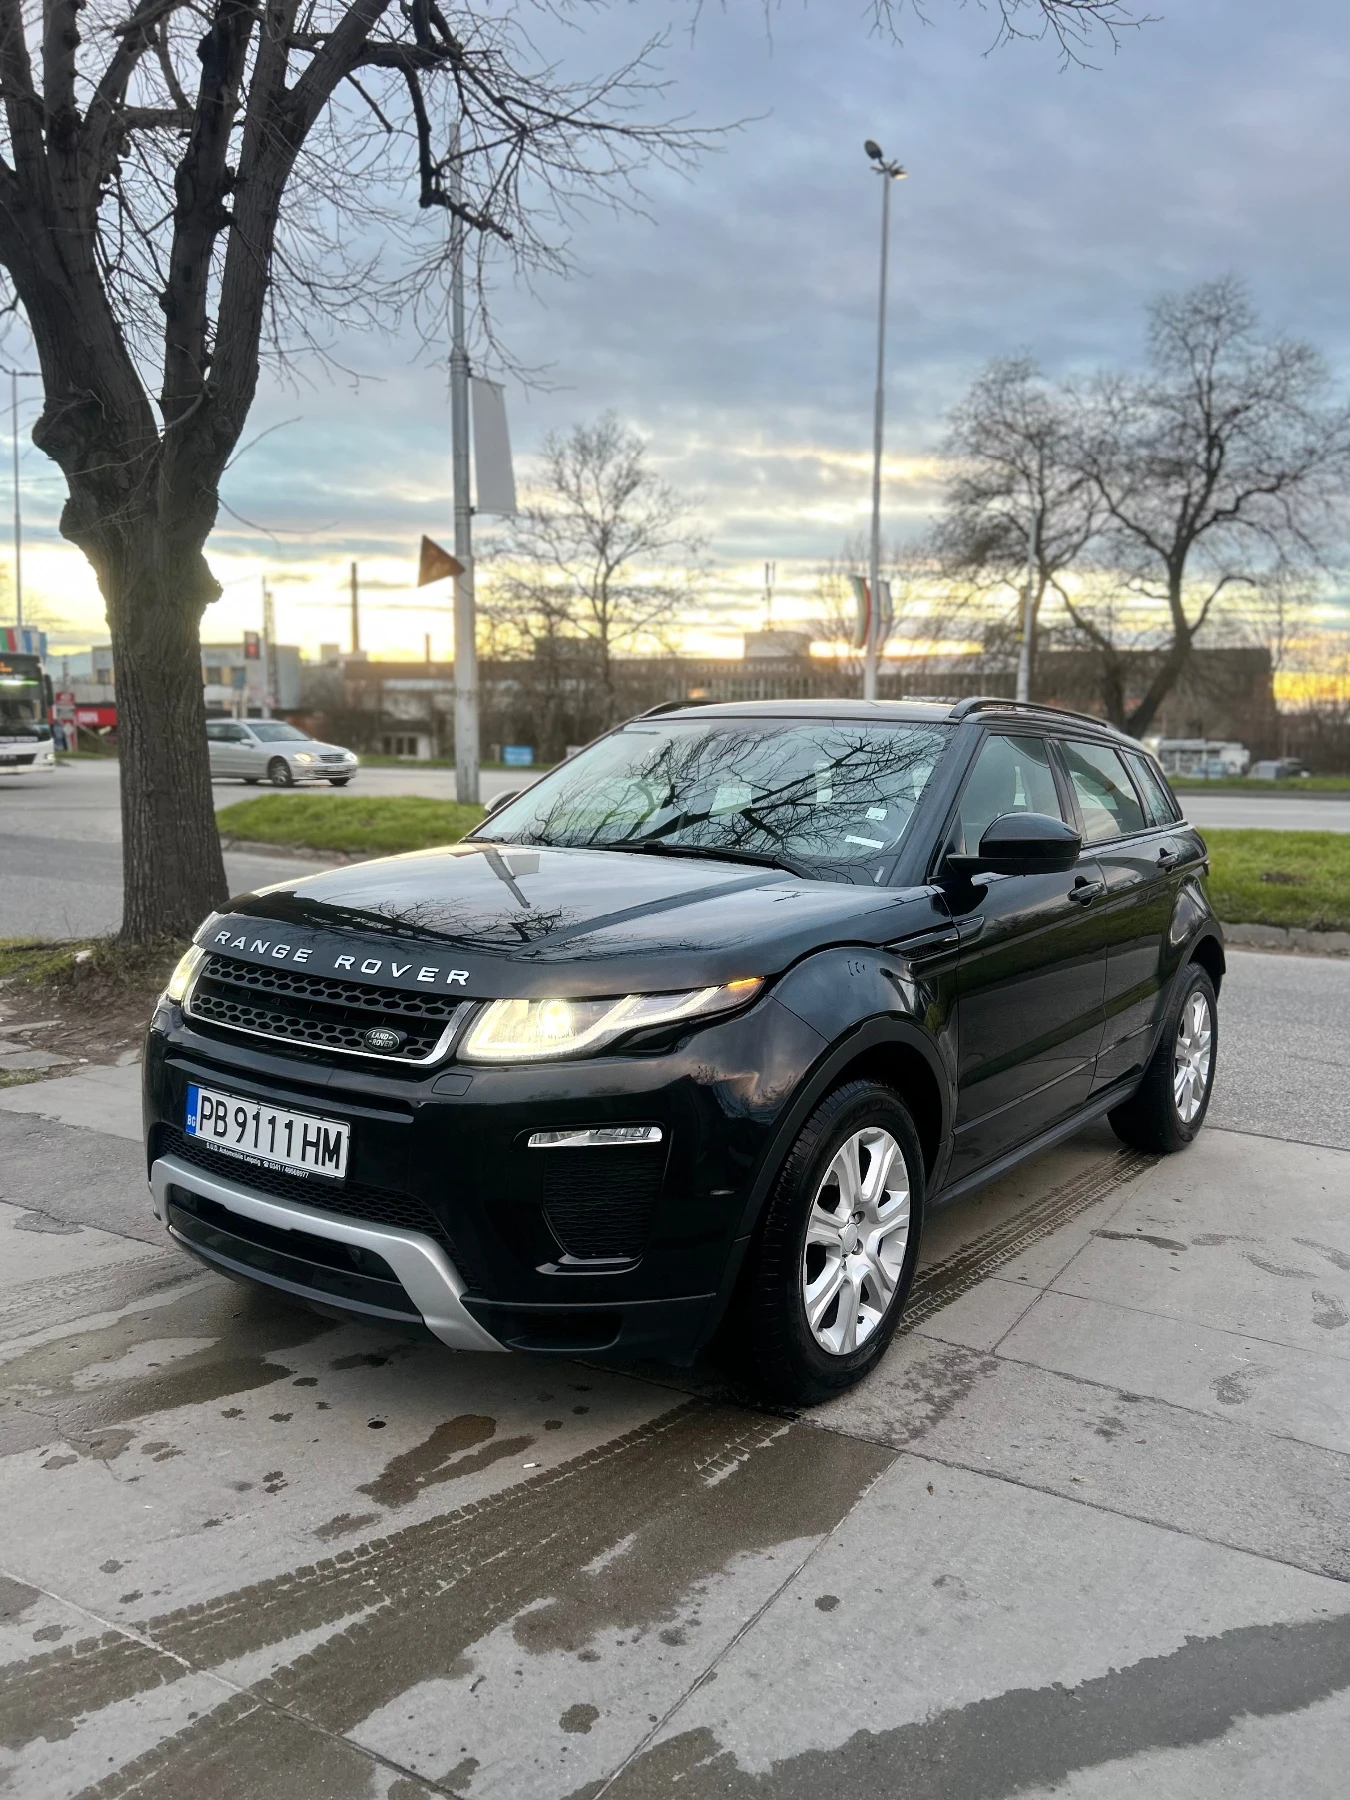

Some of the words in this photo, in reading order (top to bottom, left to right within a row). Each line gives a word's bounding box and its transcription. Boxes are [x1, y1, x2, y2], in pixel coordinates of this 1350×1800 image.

[214, 930, 313, 963] RANGE
[333, 954, 470, 986] ROVER
[370, 1031, 390, 1040] LAND
[371, 1038, 394, 1048] ROVER
[187, 1114, 196, 1127] BG
[244, 1154, 261, 1167] Leipzig
